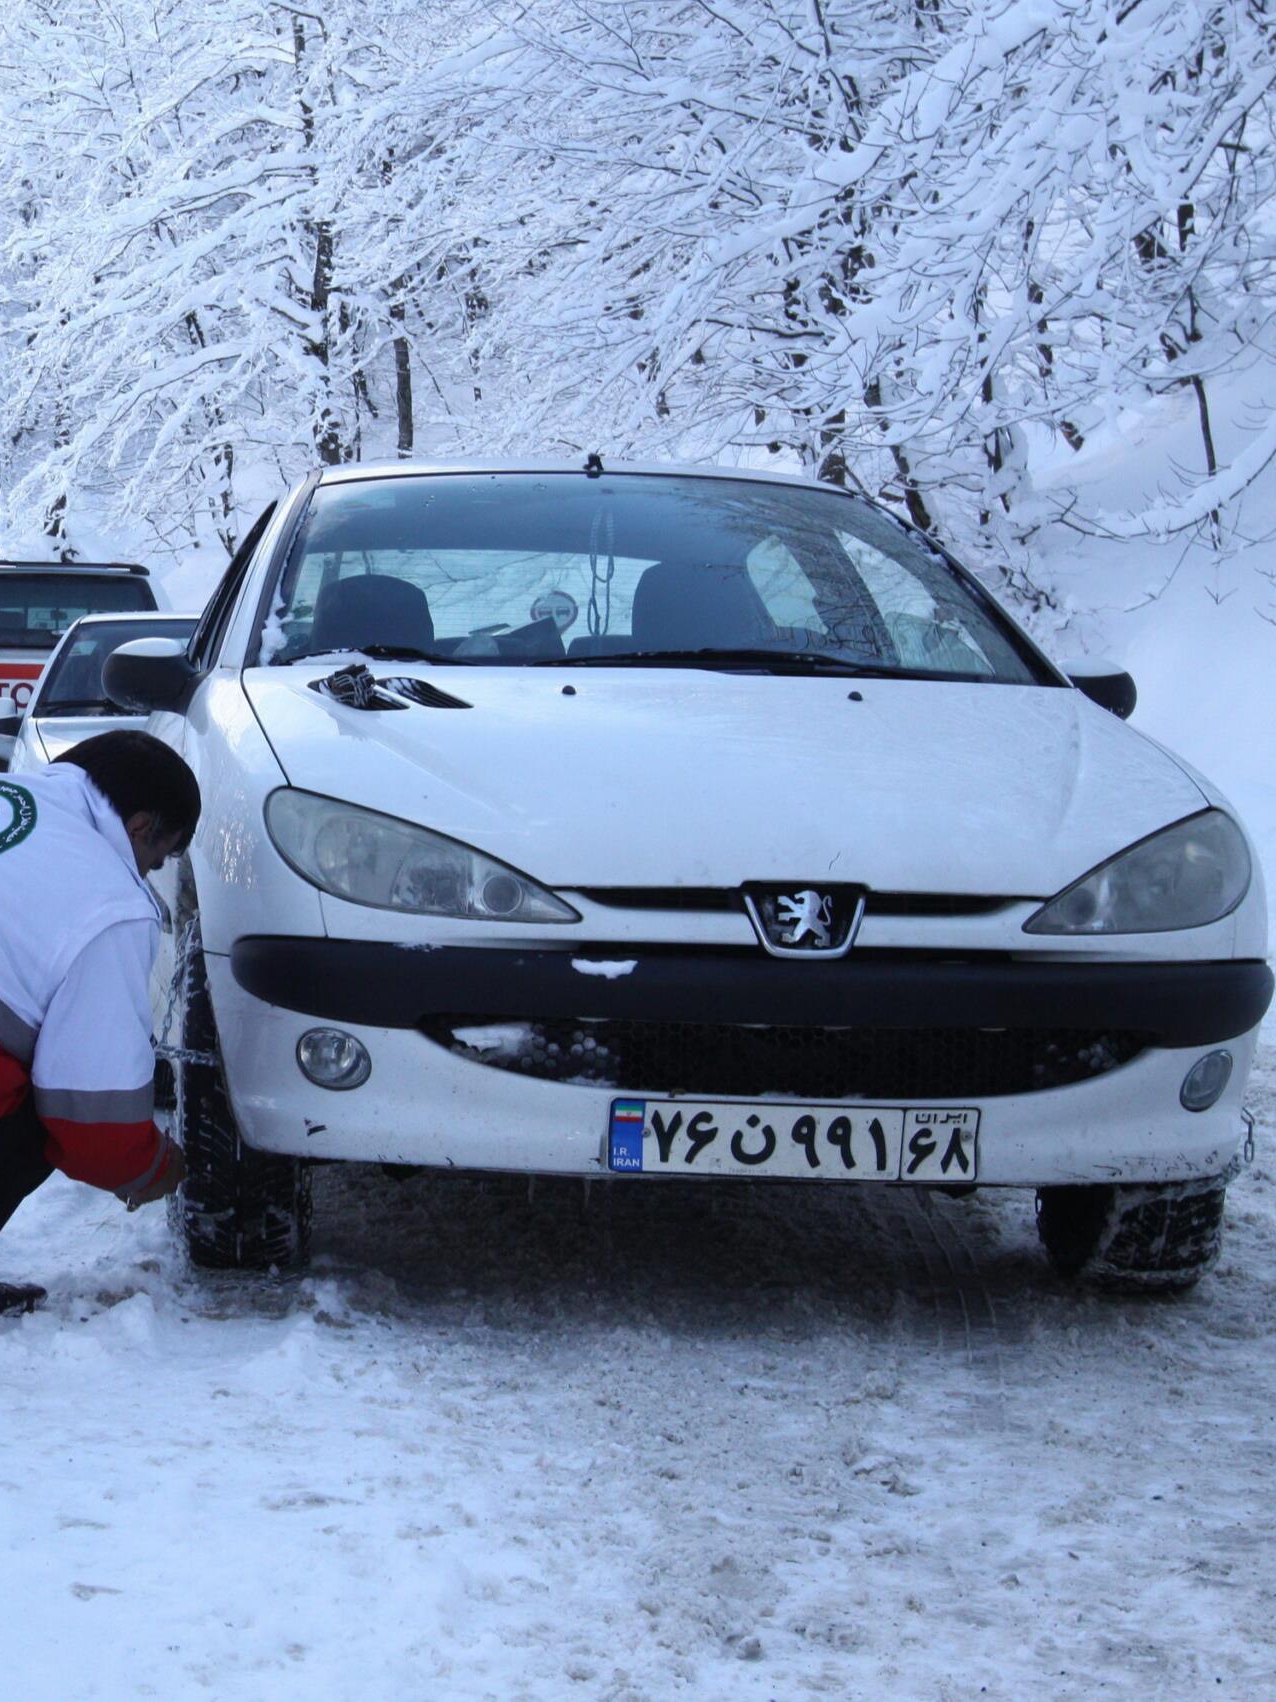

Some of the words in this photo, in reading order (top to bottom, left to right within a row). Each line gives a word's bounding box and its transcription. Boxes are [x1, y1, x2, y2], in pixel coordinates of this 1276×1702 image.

[915, 1112, 968, 1124] ایران
[613, 1147, 629, 1156] I.R.
[906, 1127, 970, 1175] ۶۸
[613, 1157, 640, 1167] IRAN
